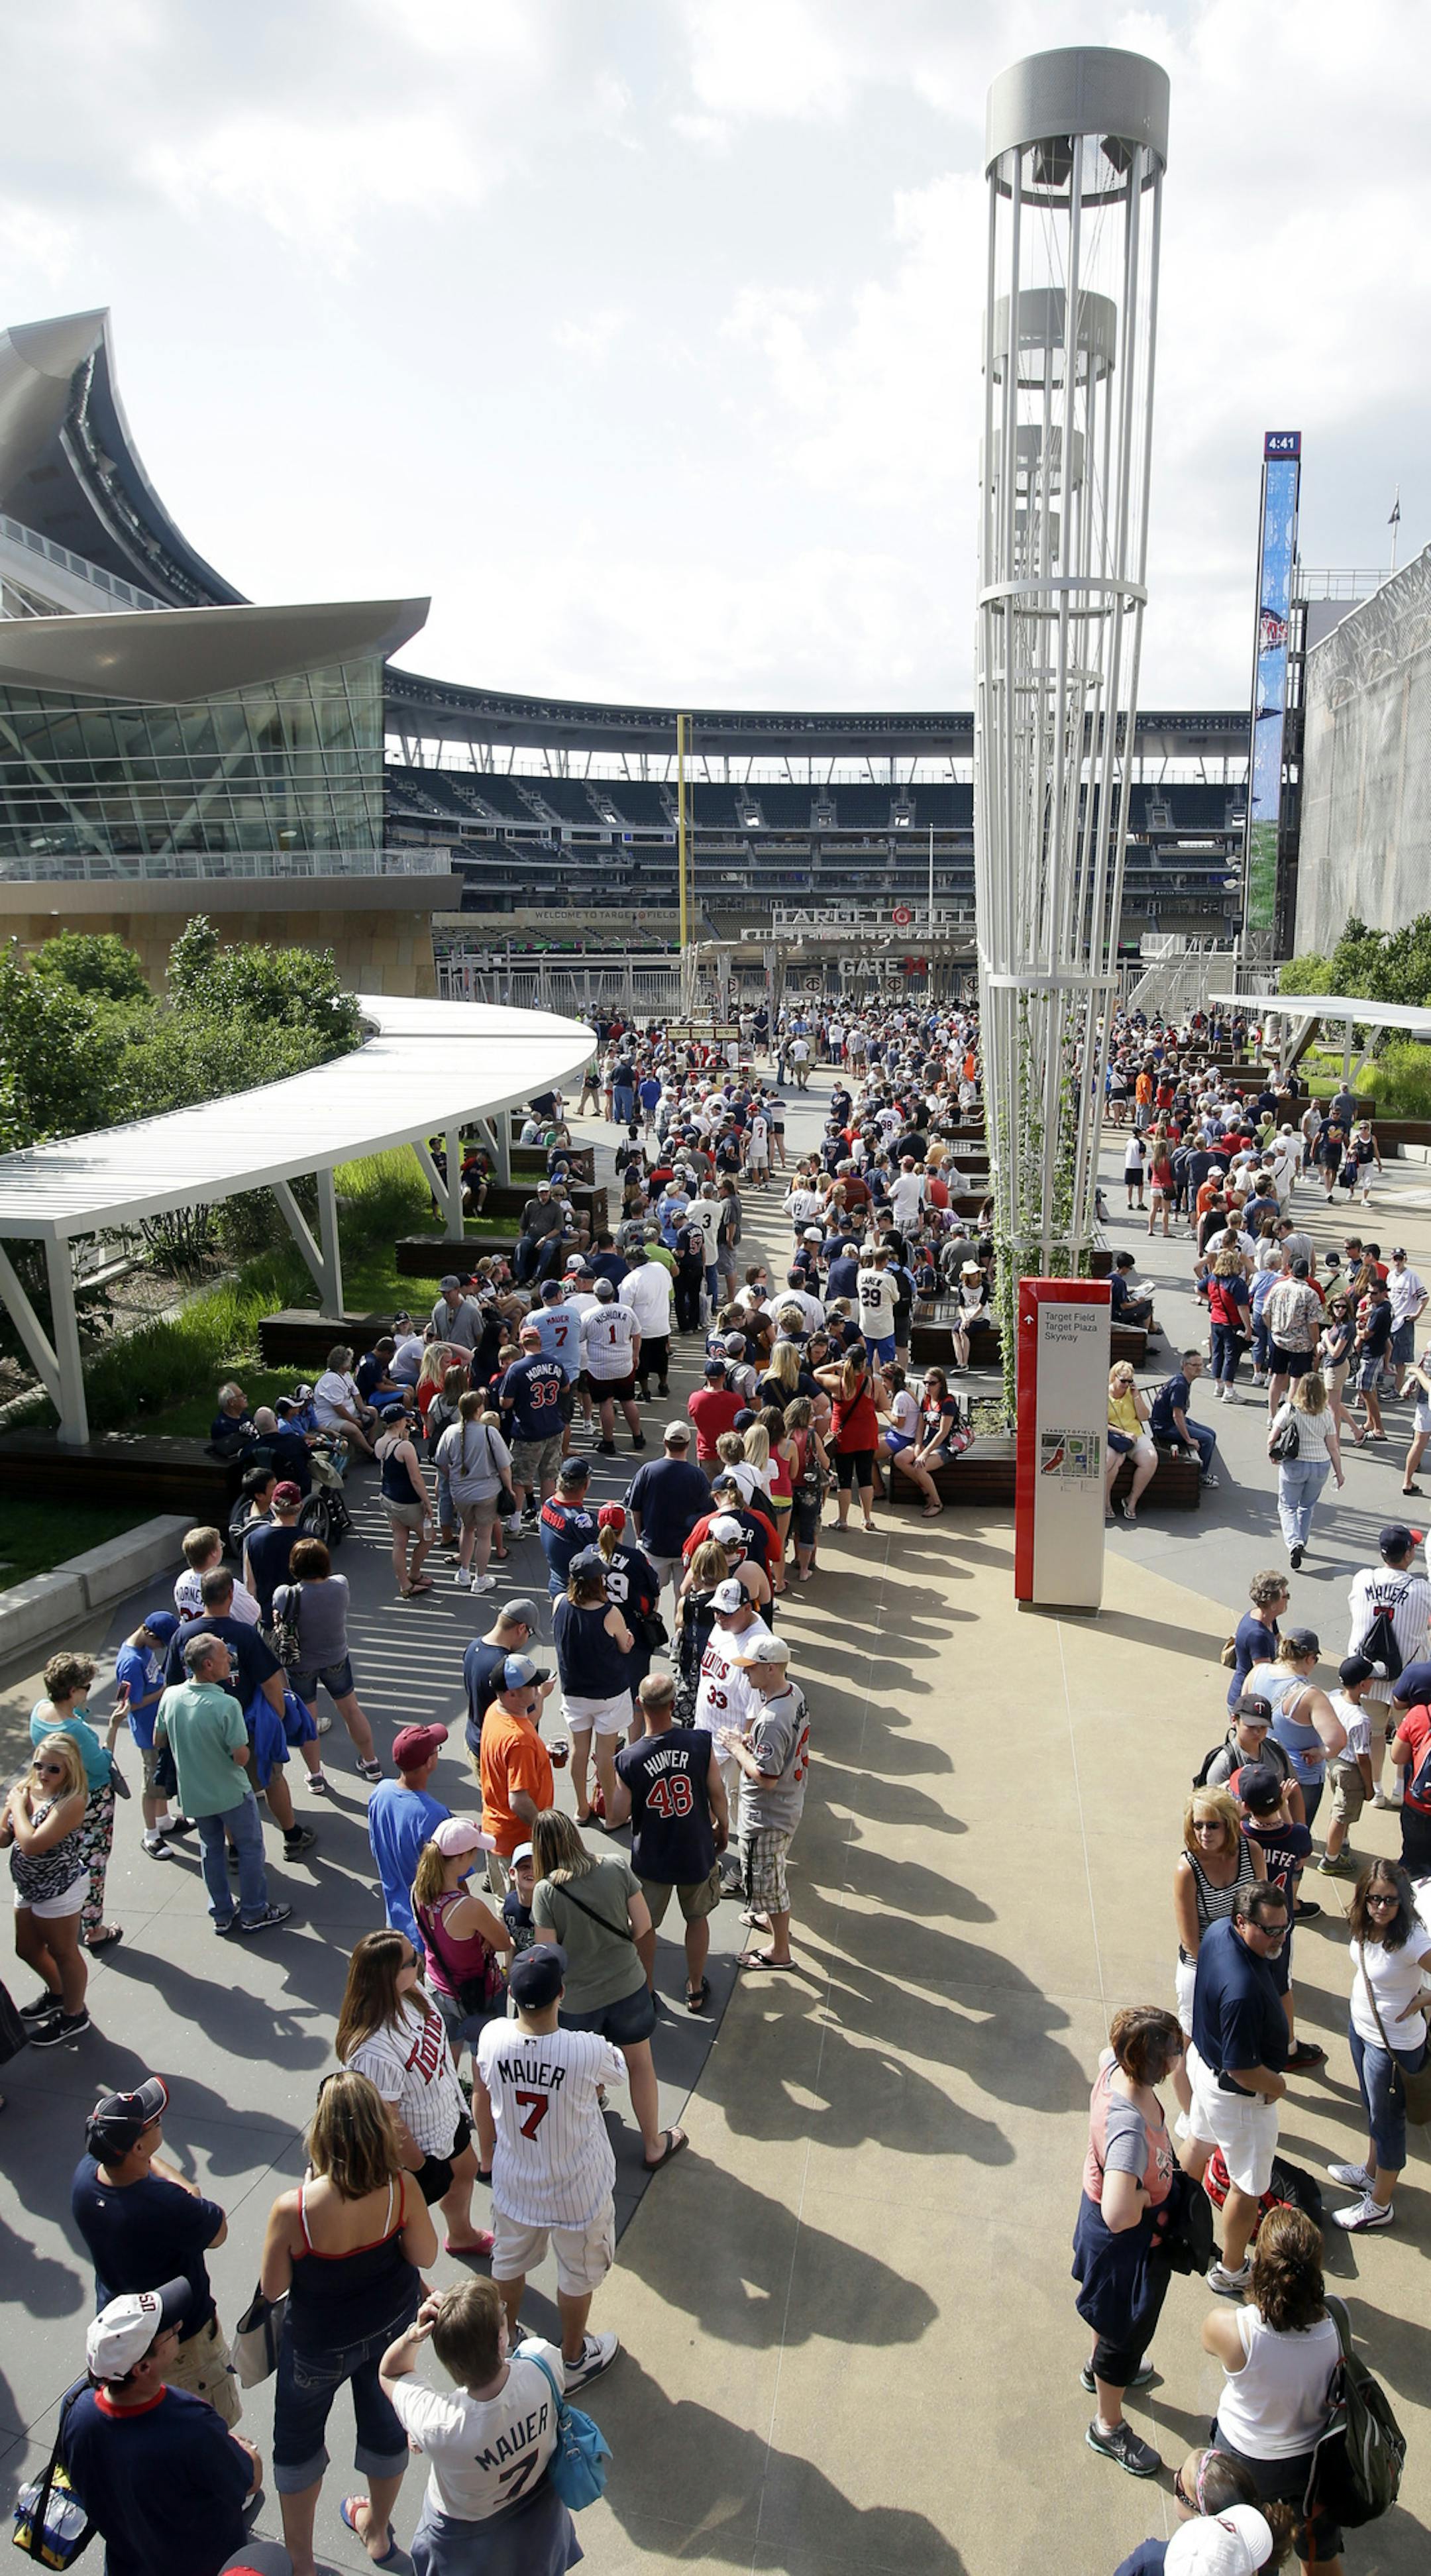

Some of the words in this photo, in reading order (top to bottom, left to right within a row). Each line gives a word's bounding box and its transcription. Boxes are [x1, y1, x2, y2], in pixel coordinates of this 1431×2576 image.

[1269, 437, 1294, 449] 4:41
[777, 910, 886, 924] TARGET
[915, 909, 976, 924] FIEL
[837, 957, 898, 977] GATE
[904, 956, 926, 976] 34
[702, 1213, 711, 1228] 3
[861, 1287, 881, 1307] 29
[546, 1315, 570, 1324] MAUER
[1045, 1313, 1071, 1322] Target
[1074, 1313, 1095, 1322] Field
[1045, 1322, 1071, 1332] Target
[1074, 1323, 1097, 1332] Plaza
[555, 1326, 568, 1347] 7
[609, 1325, 617, 1344] 1
[1045, 1332, 1078, 1342] Skyway
[531, 1380, 560, 1409] 33
[1365, 1584, 1409, 1606] MAUER
[707, 1685, 727, 1709] 33
[643, 1749, 689, 1777] HUNTER
[646, 1774, 694, 1818] 48
[498, 2059, 566, 2090] MAUER
[515, 2090, 549, 2141] 7
[474, 2402, 548, 2472] MAUER
[492, 2447, 539, 2505] 7
